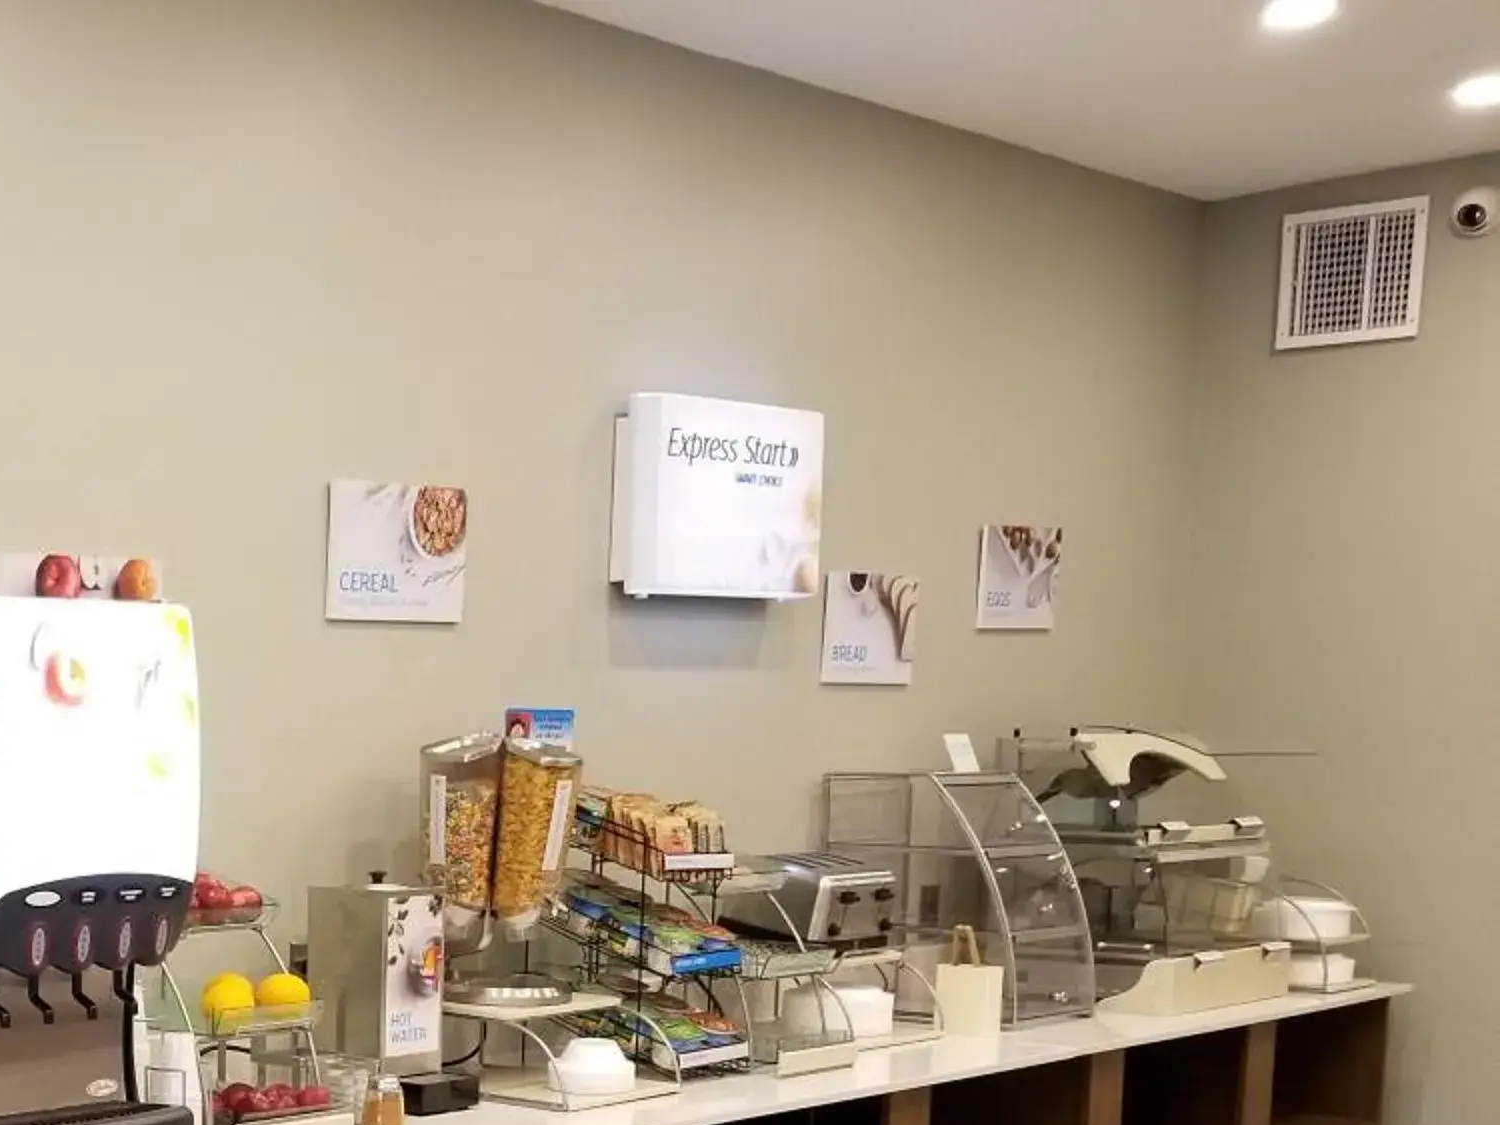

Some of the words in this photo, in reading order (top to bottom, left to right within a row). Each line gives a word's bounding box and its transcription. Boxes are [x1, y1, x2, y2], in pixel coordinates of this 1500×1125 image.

[667, 427, 738, 467] Express
[743, 435, 788, 467] Start
[339, 571, 399, 593] CEREAL
[831, 644, 868, 662] BREAD
[391, 1012, 413, 1027] HOT
[391, 1027, 427, 1044] WATER
